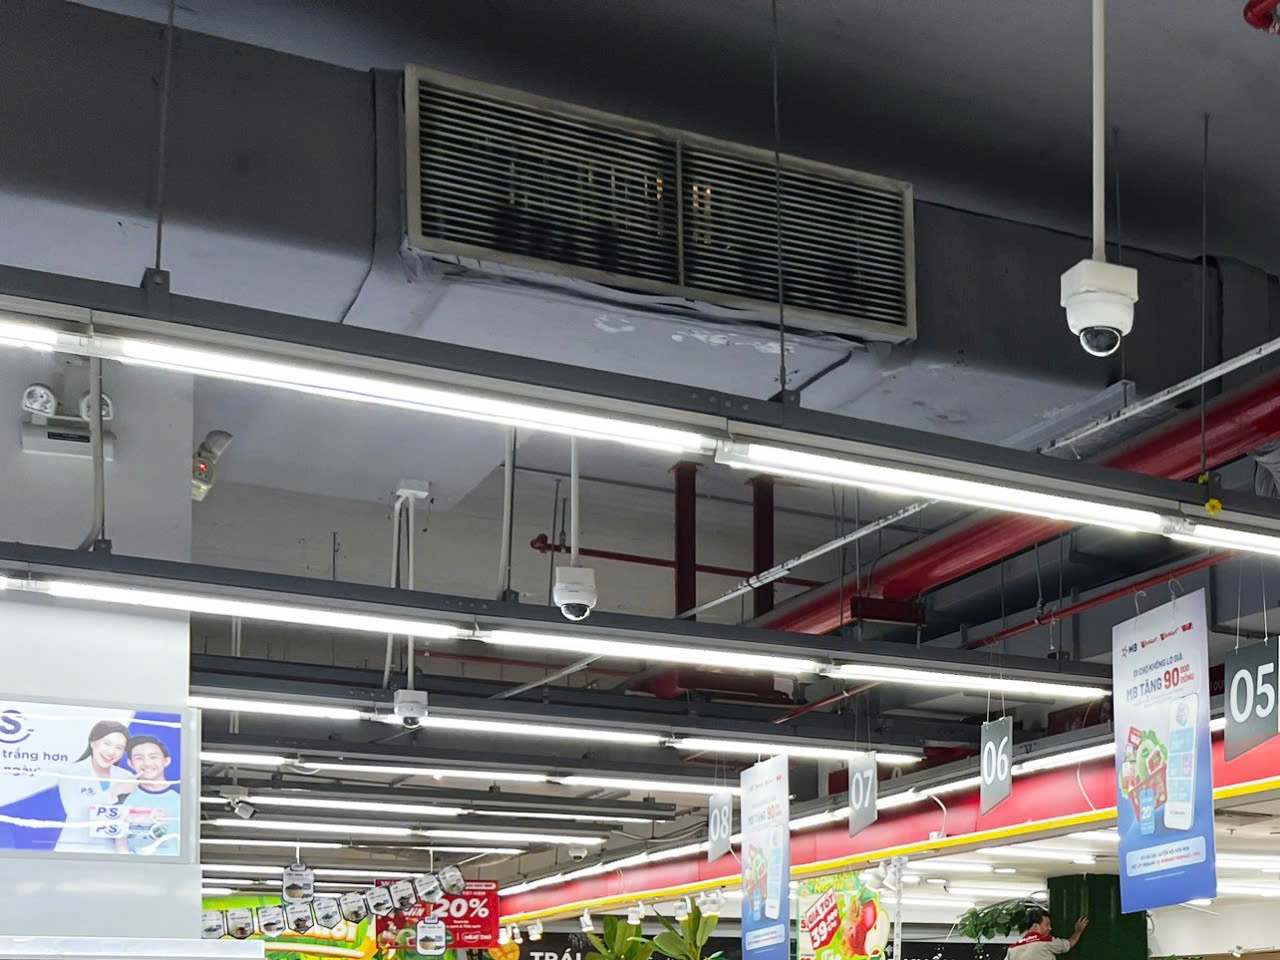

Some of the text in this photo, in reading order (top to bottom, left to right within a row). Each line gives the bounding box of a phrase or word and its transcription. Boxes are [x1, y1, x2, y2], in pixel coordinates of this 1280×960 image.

[1164, 667, 1179, 689] 90
[1230, 662, 1275, 723] 05
[983, 736, 1009, 785] 06
[852, 768, 874, 811] 07
[96, 806, 119, 818] PS
[711, 807, 729, 840] 08
